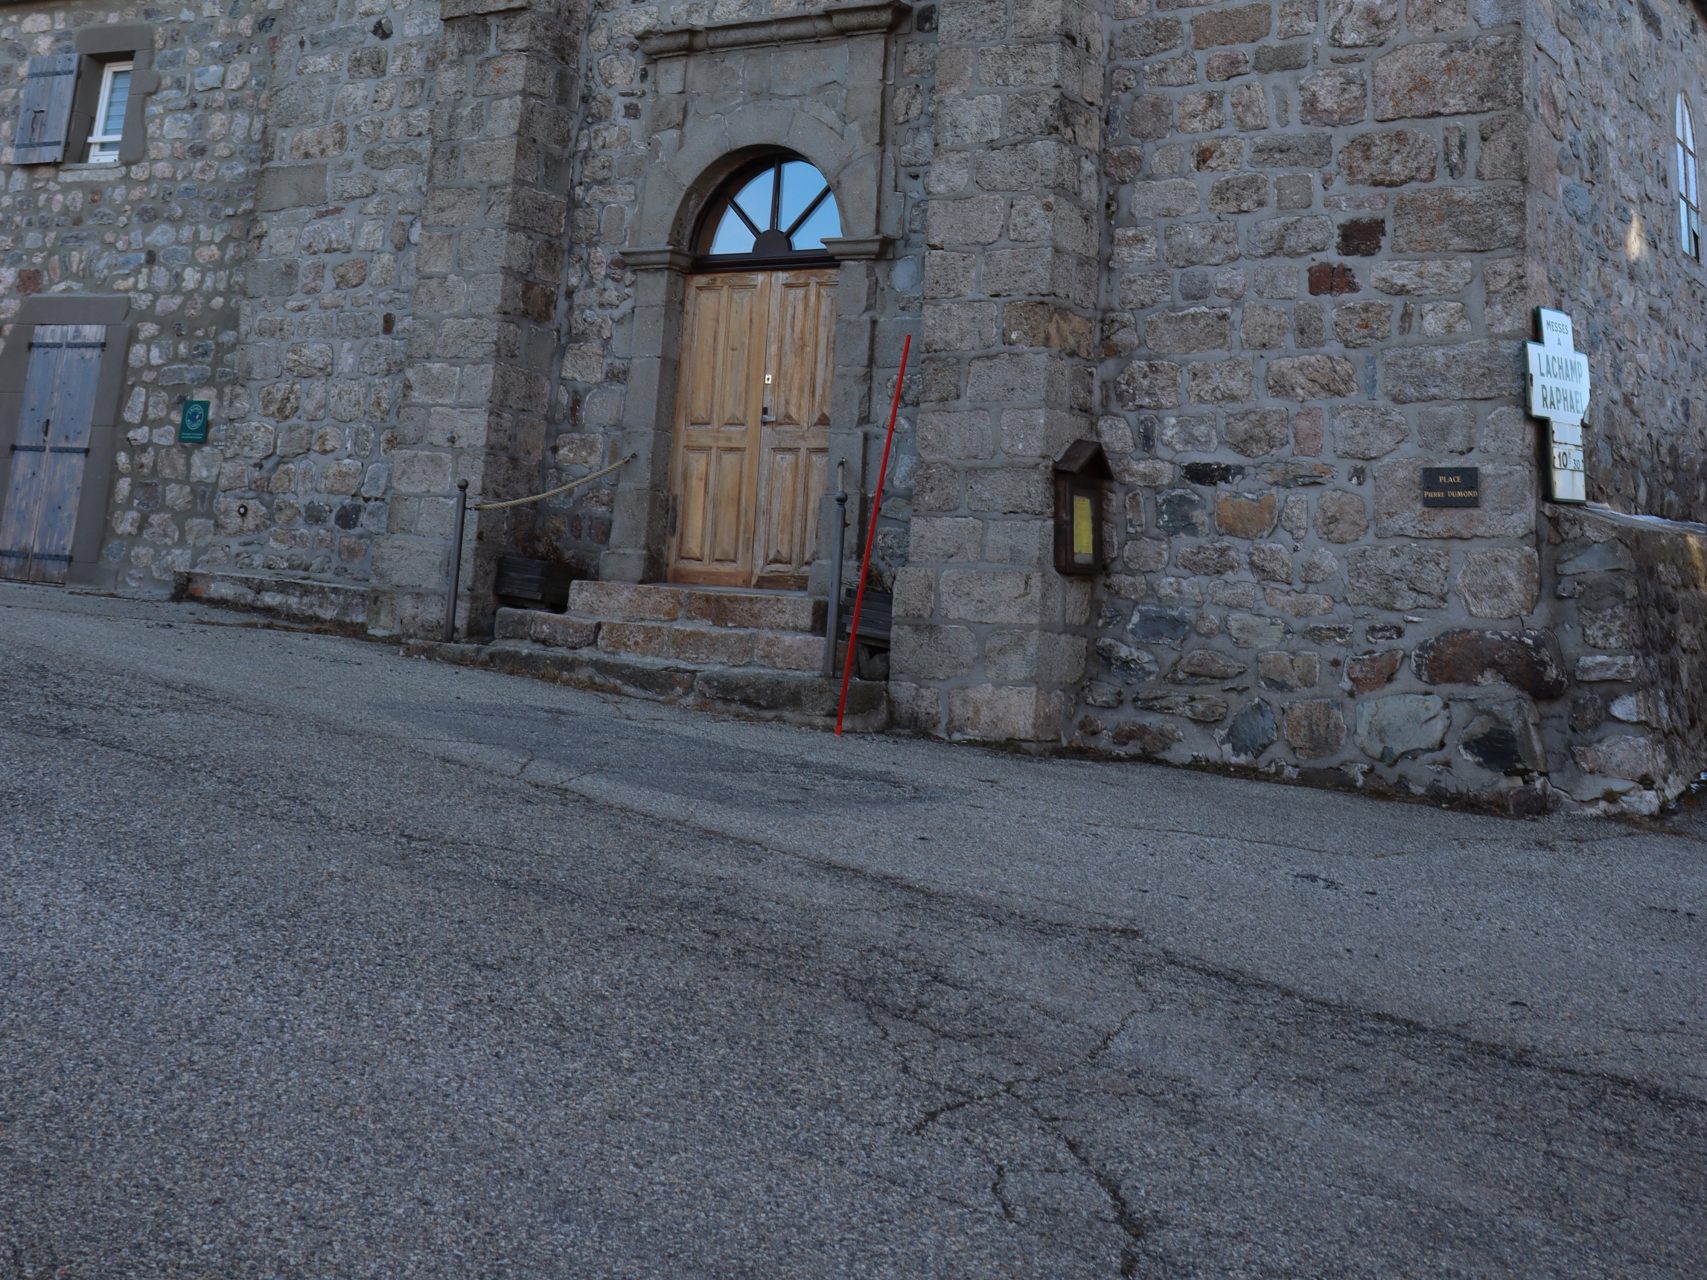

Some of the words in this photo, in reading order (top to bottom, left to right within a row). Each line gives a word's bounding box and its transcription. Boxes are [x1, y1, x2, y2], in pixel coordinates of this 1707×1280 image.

[1546, 320, 1568, 335] MESSES
[1538, 352, 1583, 384] LACHAMP
[1439, 475, 1462, 483] PLACE
[1447, 490, 1478, 498] DUMOND
